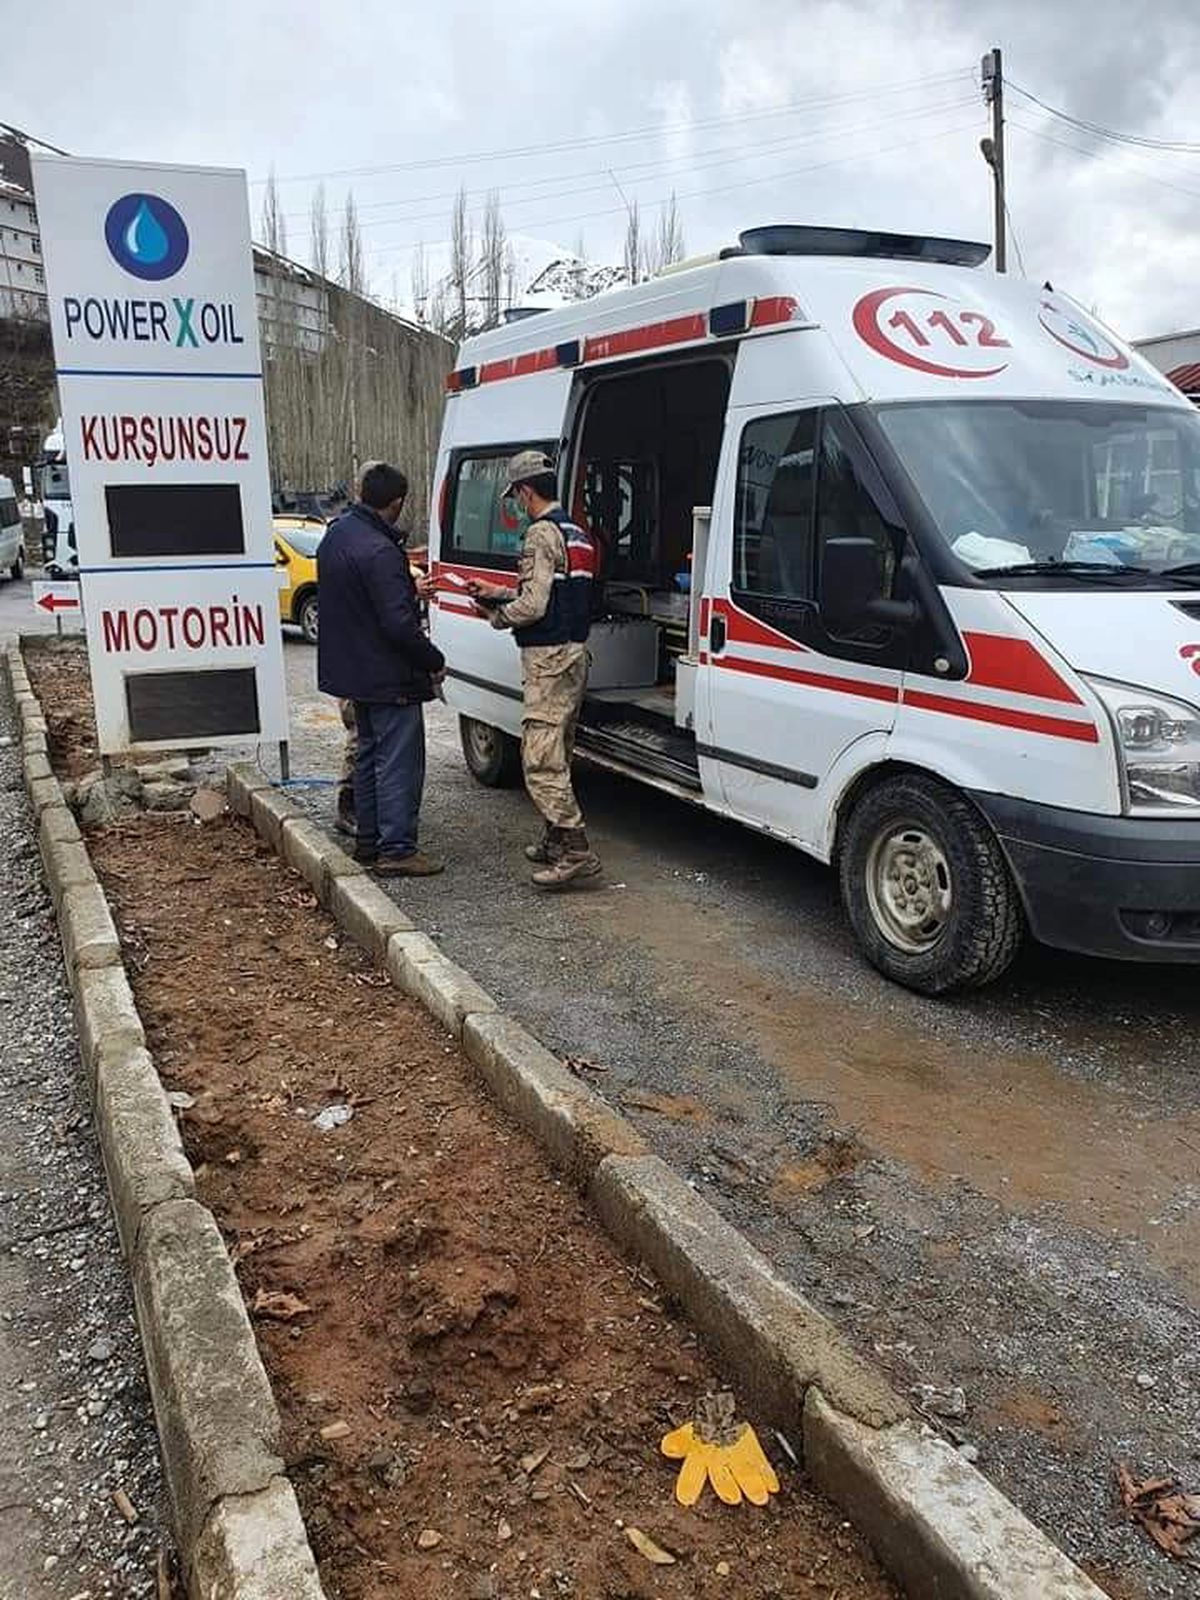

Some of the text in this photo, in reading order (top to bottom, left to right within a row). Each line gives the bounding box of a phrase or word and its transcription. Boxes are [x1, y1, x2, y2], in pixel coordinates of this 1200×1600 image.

[888, 310, 1012, 348] 112
[81, 415, 249, 467] KURŞUNSUZ
[102, 594, 264, 652] MOTORİN
